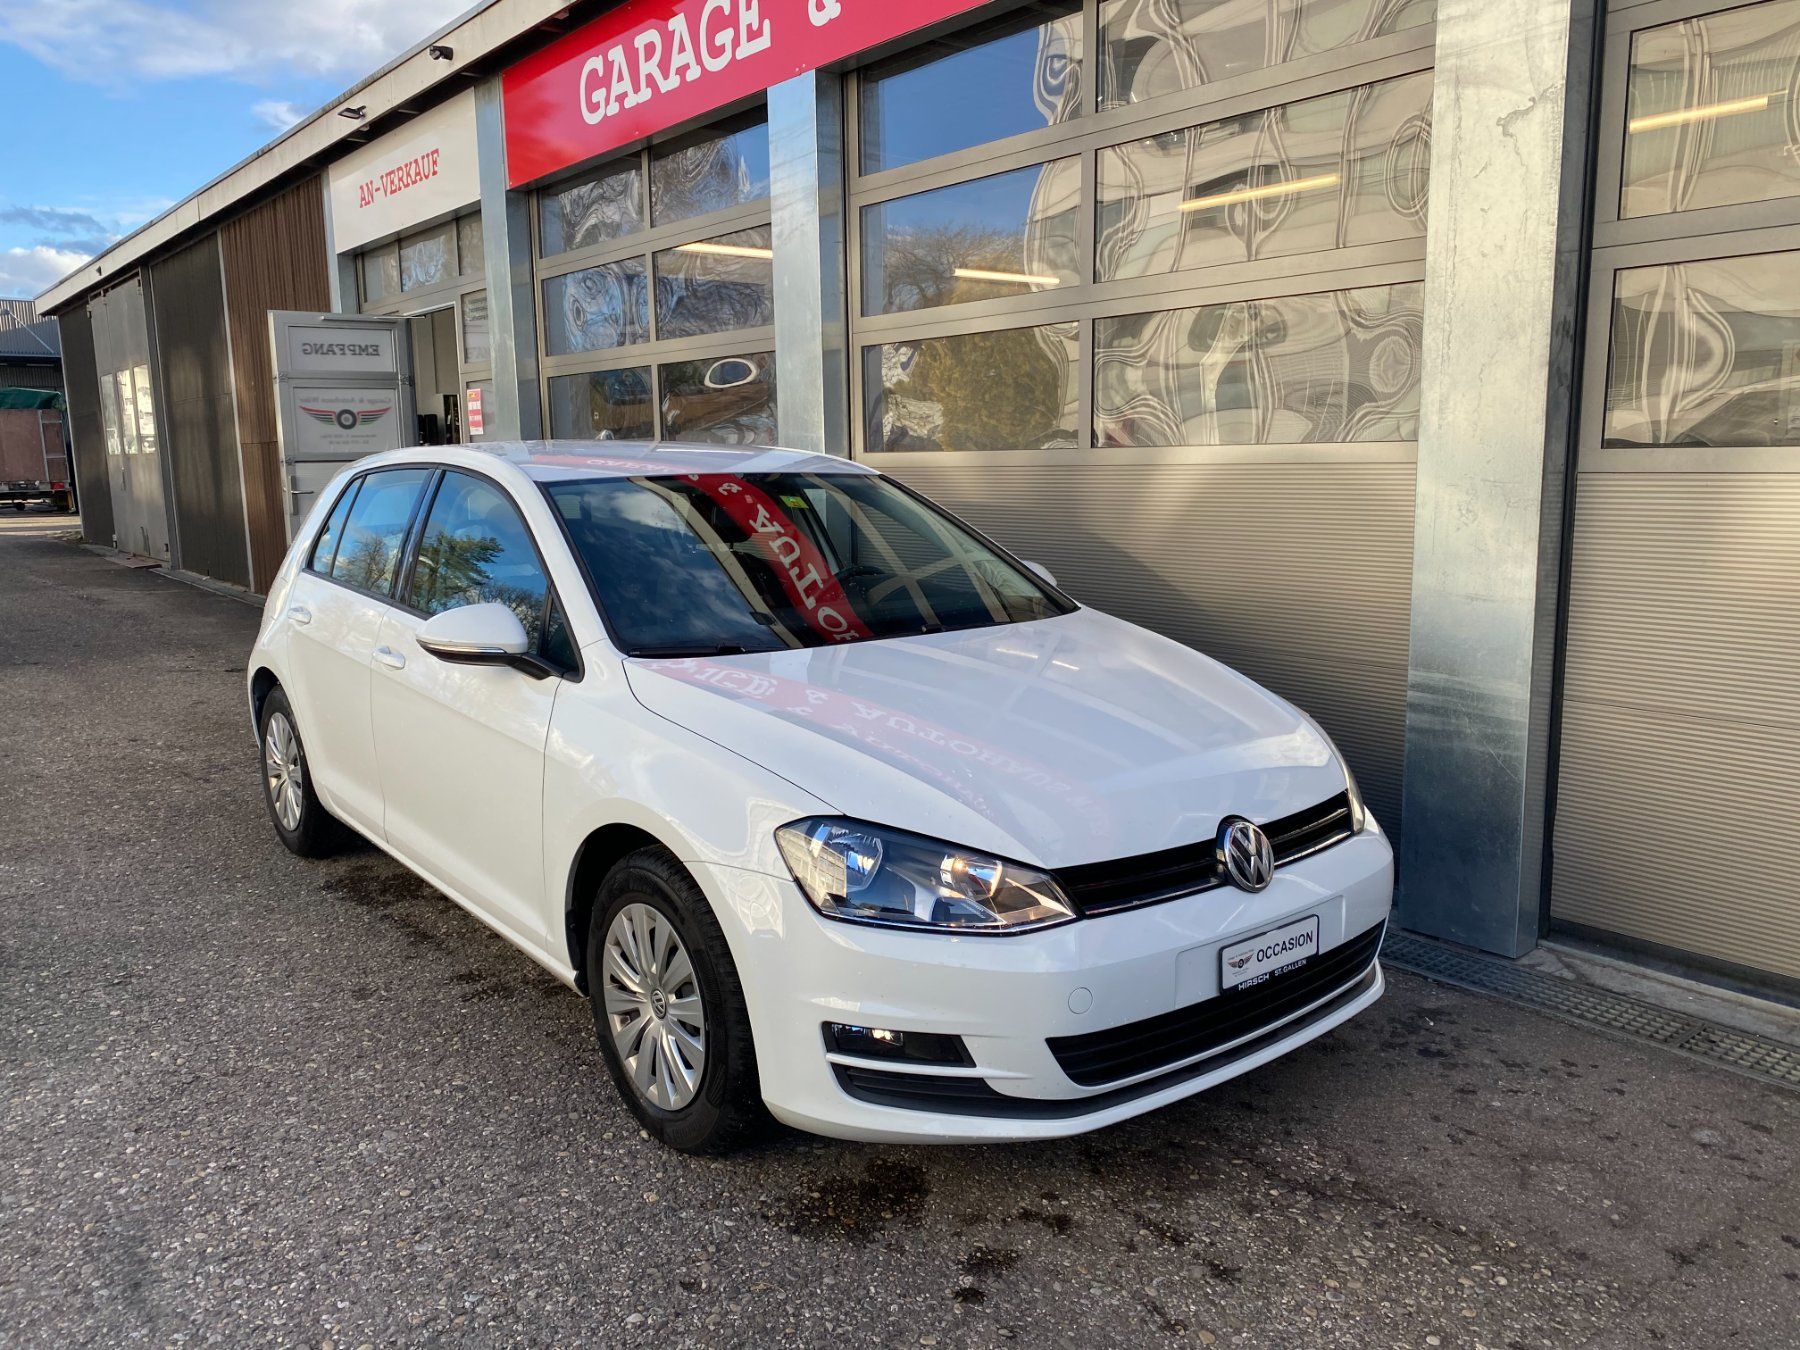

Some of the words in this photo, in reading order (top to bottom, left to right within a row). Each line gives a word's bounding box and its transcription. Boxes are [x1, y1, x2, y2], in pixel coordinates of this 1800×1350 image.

[579, 0, 771, 125] GARAGE
[359, 148, 440, 208] AN-VERKAUF
[1256, 930, 1314, 963] OCCASION
[1238, 973, 1270, 991] HIRSCH
[1283, 959, 1307, 973] GALLEN
